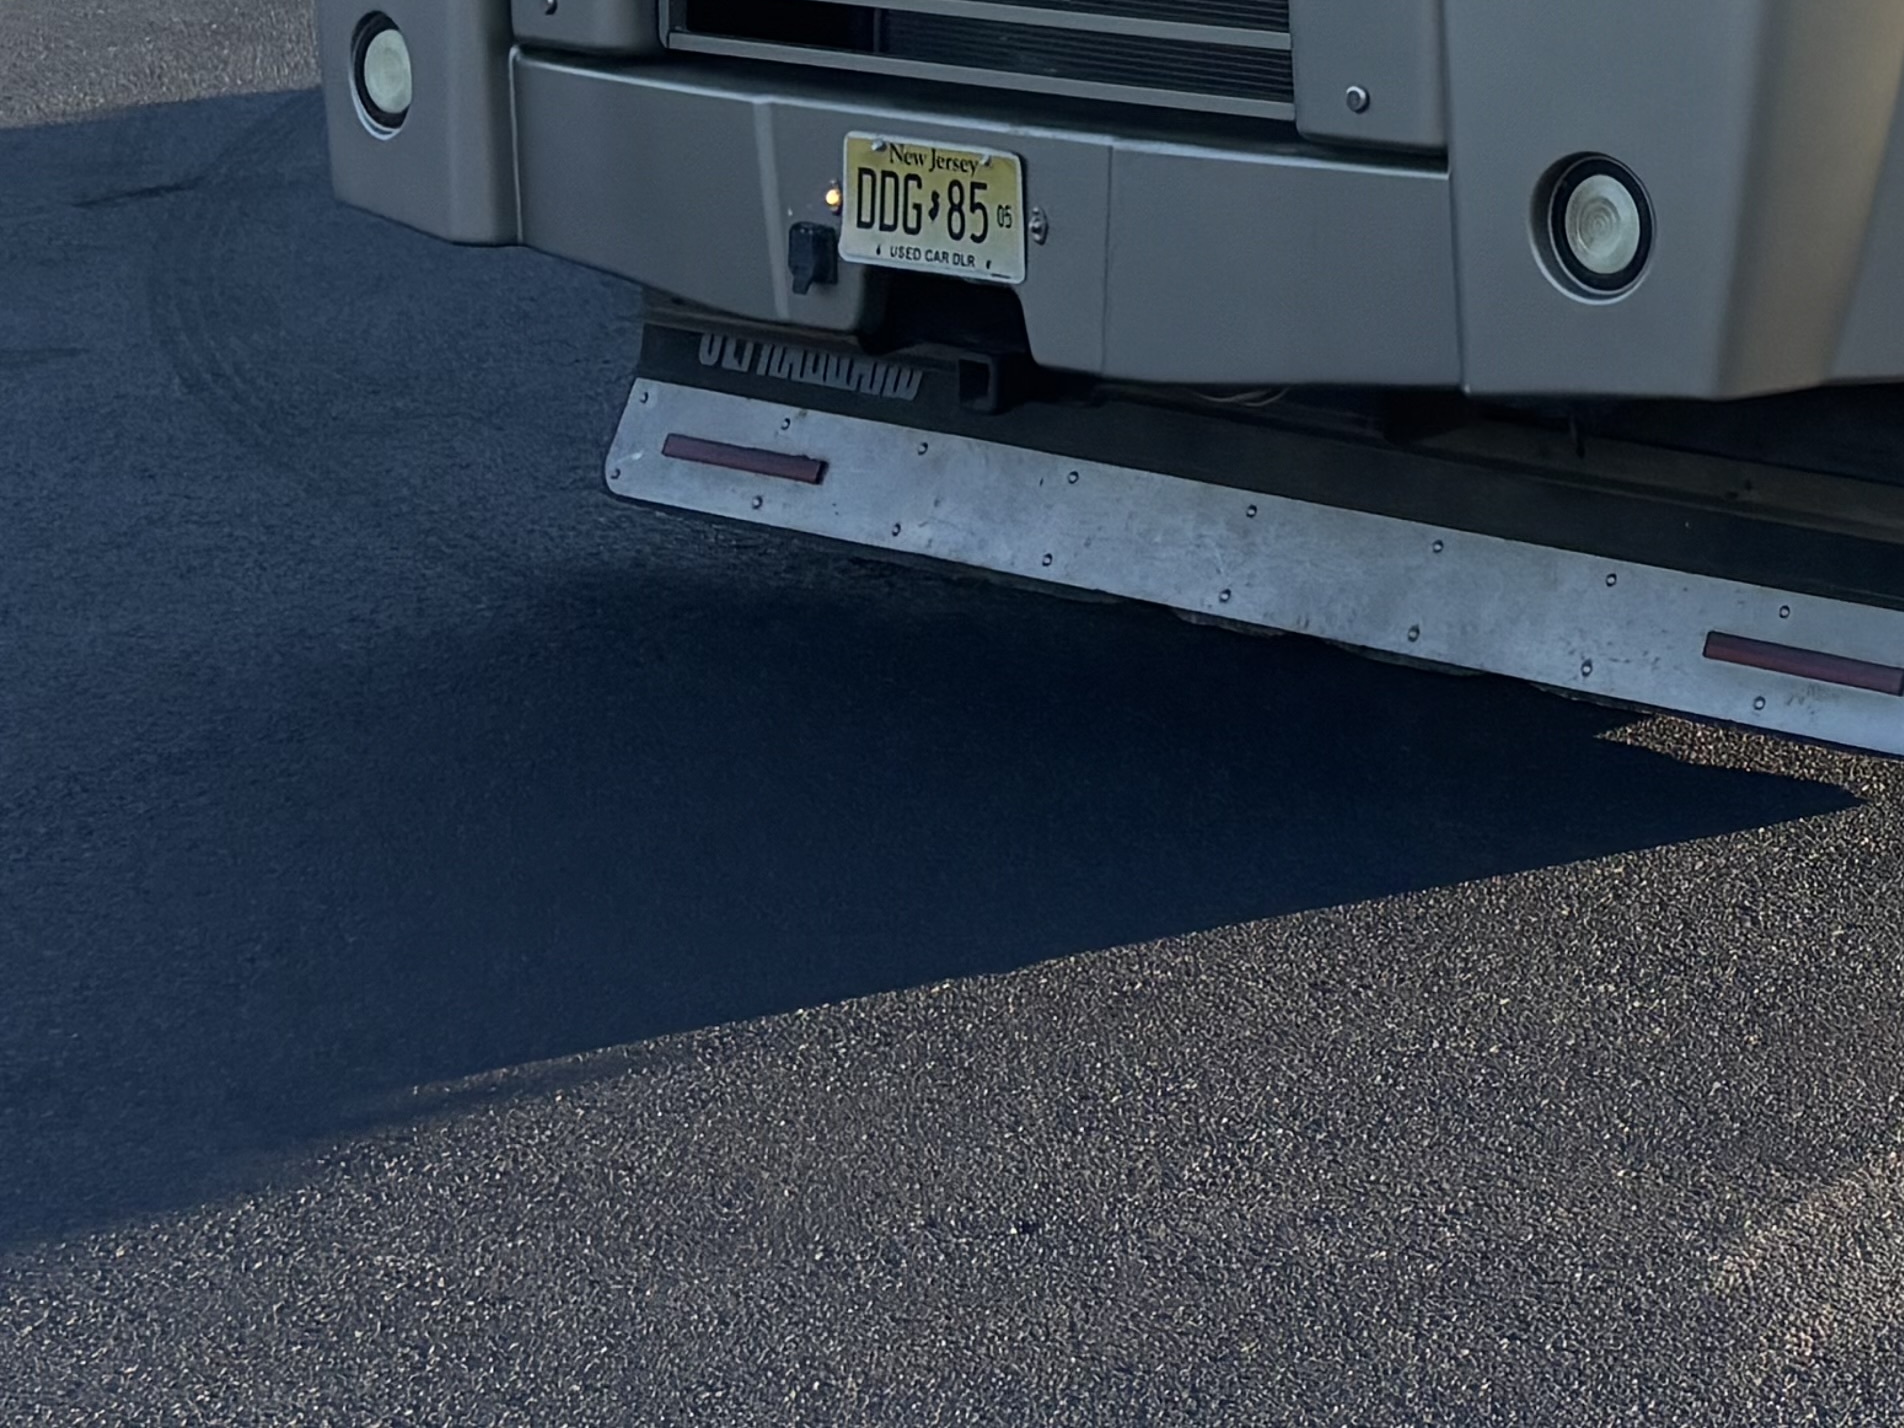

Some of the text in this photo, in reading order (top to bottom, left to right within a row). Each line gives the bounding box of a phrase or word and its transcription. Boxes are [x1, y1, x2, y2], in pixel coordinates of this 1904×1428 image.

[889, 143, 980, 176] New Jersey
[889, 244, 976, 268] USED CAR DLR
